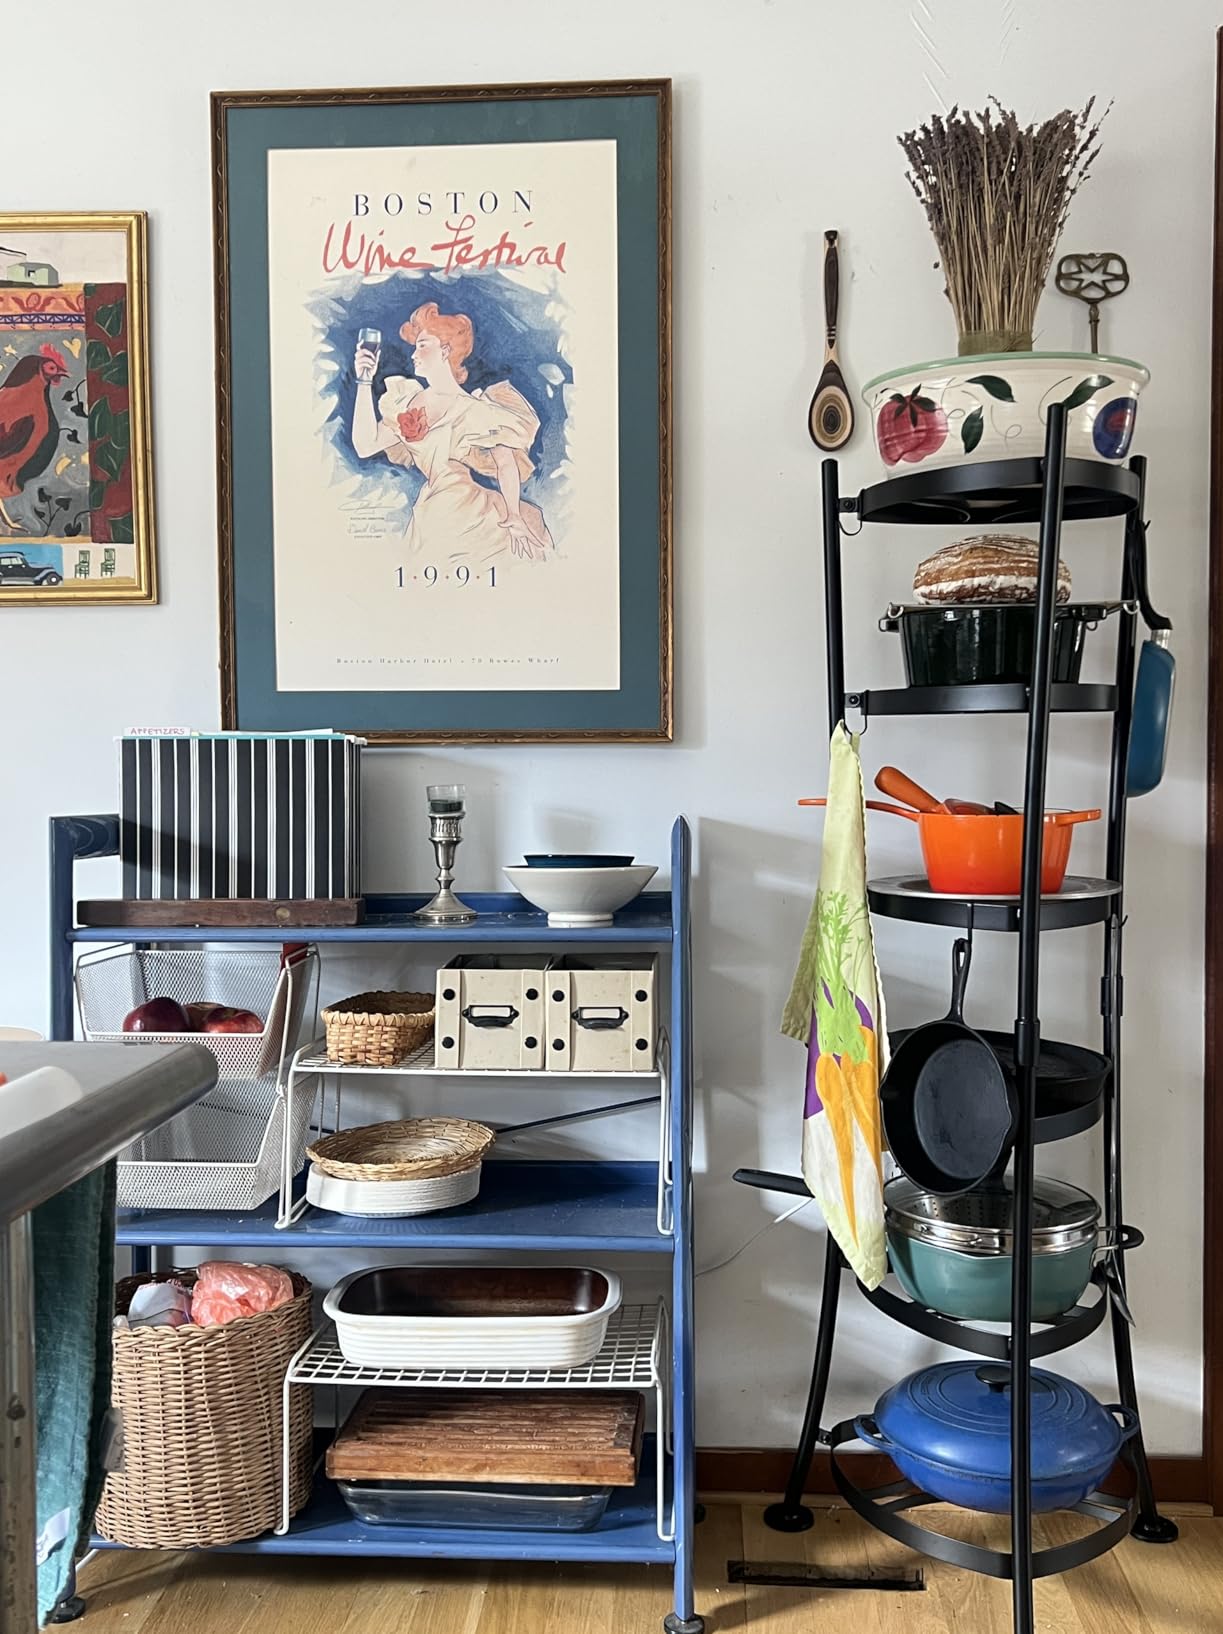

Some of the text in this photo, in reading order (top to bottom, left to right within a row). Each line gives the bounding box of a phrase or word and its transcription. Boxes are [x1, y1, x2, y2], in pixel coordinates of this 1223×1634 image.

[352, 190, 534, 217] BOSTON
[322, 214, 567, 277] Wine Festival
